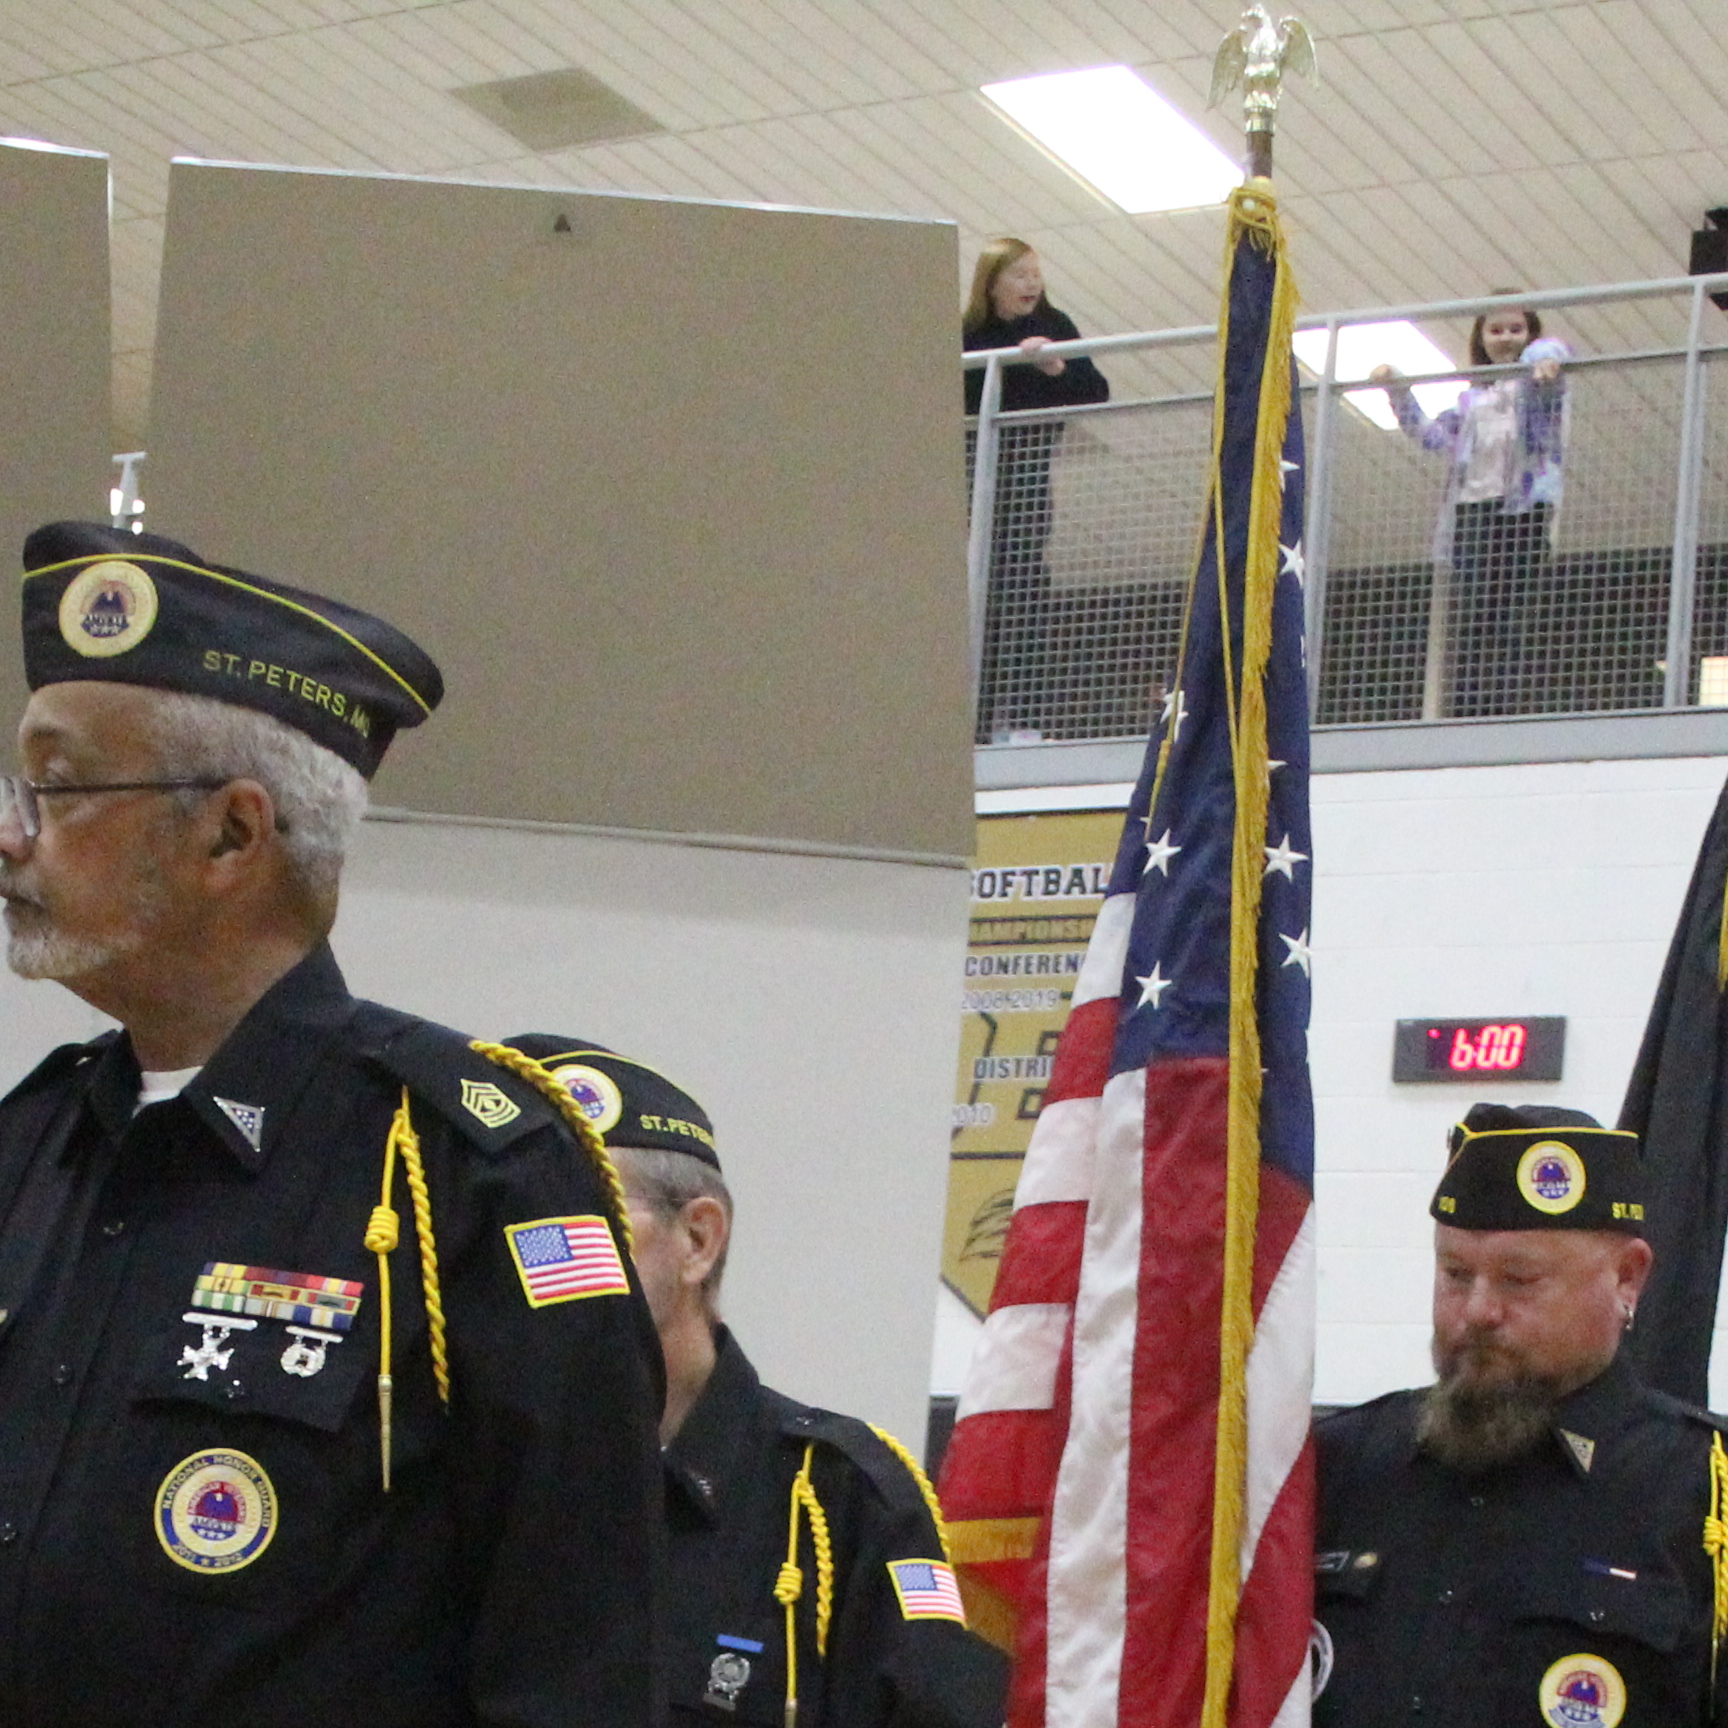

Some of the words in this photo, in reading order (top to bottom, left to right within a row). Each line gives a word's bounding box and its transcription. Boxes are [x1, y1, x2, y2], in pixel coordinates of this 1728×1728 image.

[971, 866, 1111, 899] OFTBAL
[1449, 1023, 1527, 1072] 6:00
[974, 1057, 1052, 1079] DISTRI
